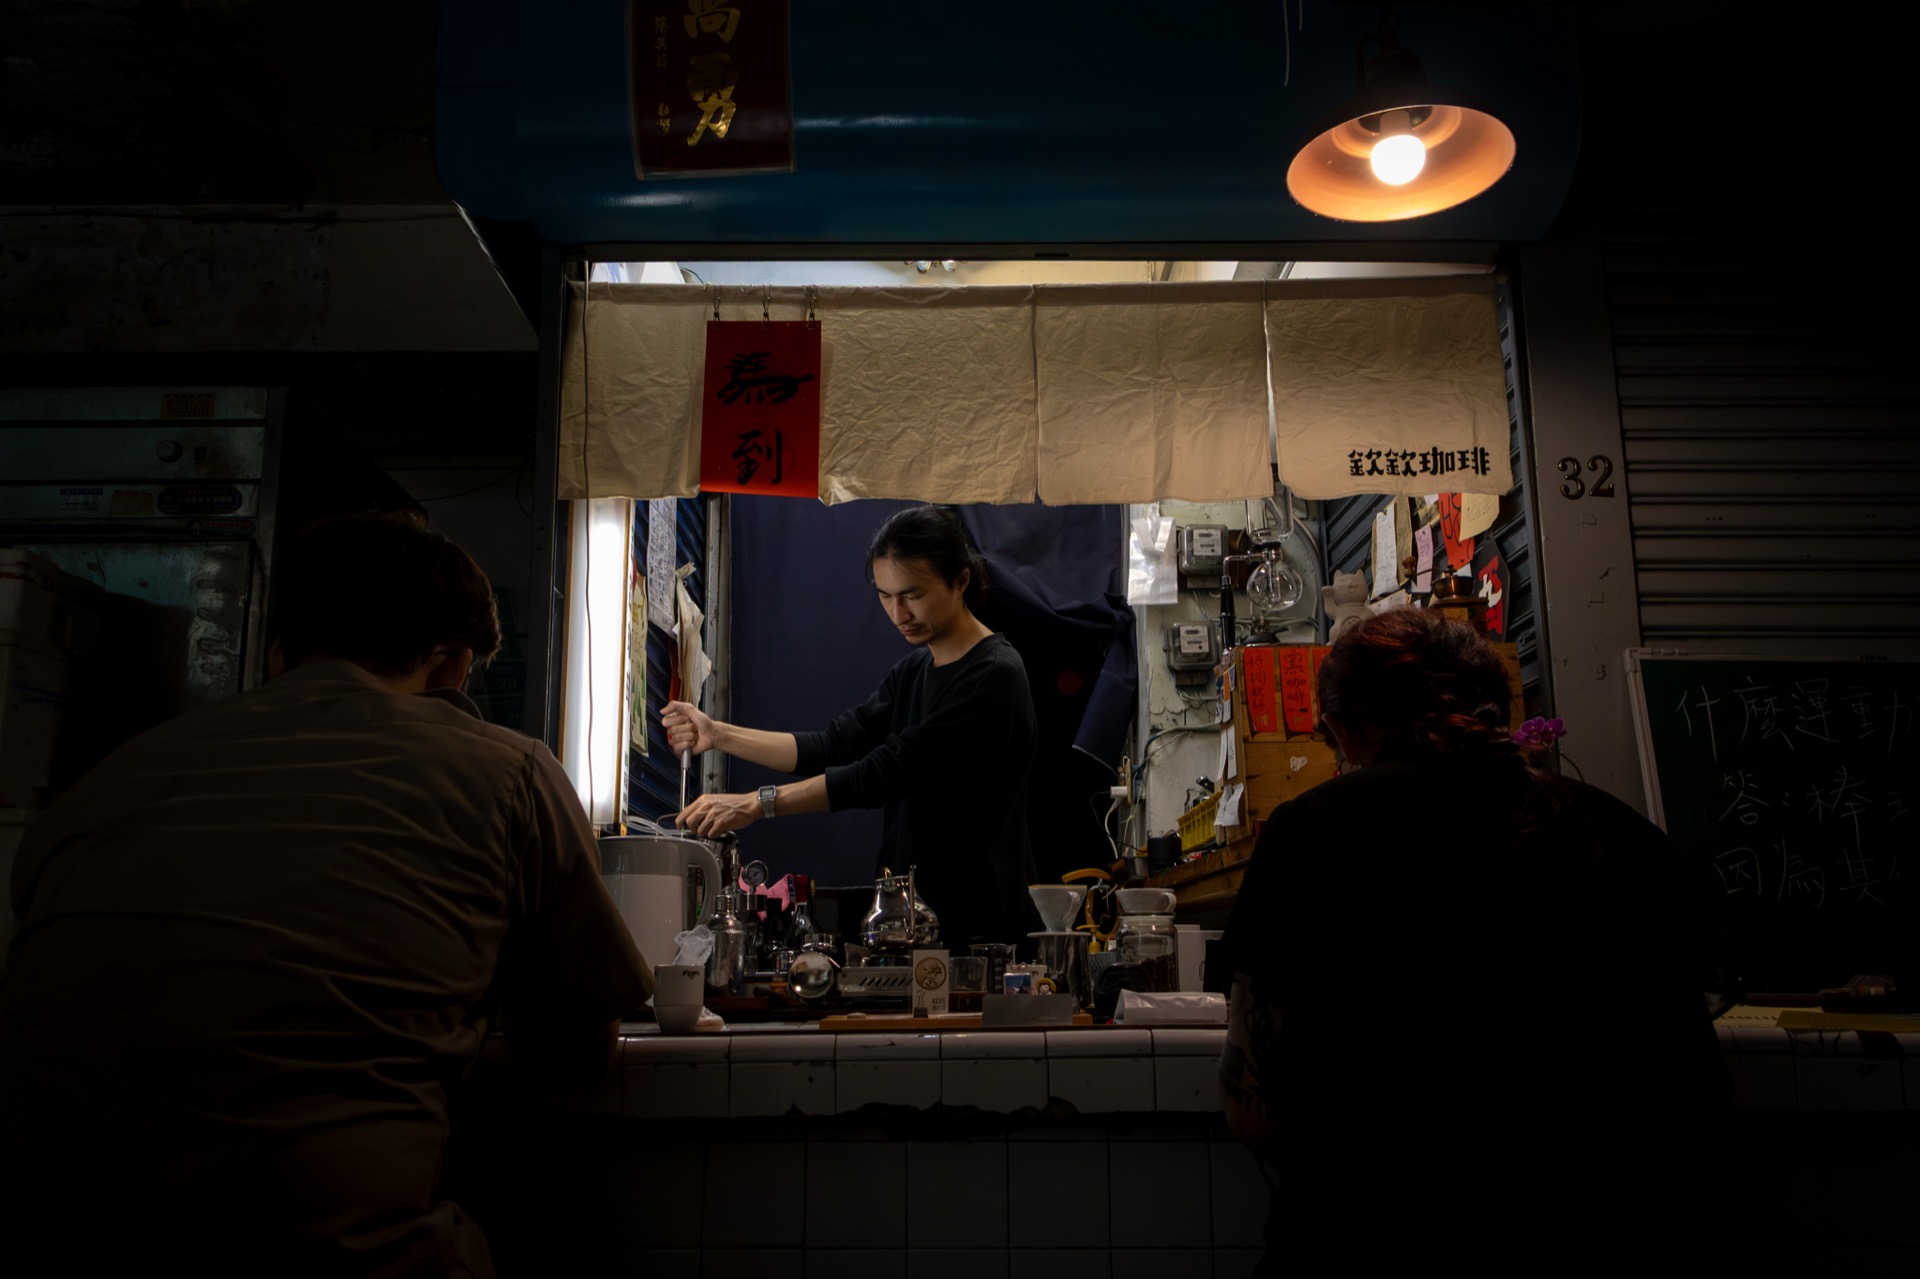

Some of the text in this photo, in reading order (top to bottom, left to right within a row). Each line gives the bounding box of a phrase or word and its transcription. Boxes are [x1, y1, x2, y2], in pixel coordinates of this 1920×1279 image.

[718, 352, 815, 485] 馬到
[1348, 446, 1490, 476] 欽欽珈琲
[1558, 455, 1615, 500] 32
[1282, 652, 1307, 705] 黑咖啡
[1675, 675, 1920, 766] 什麼運動
